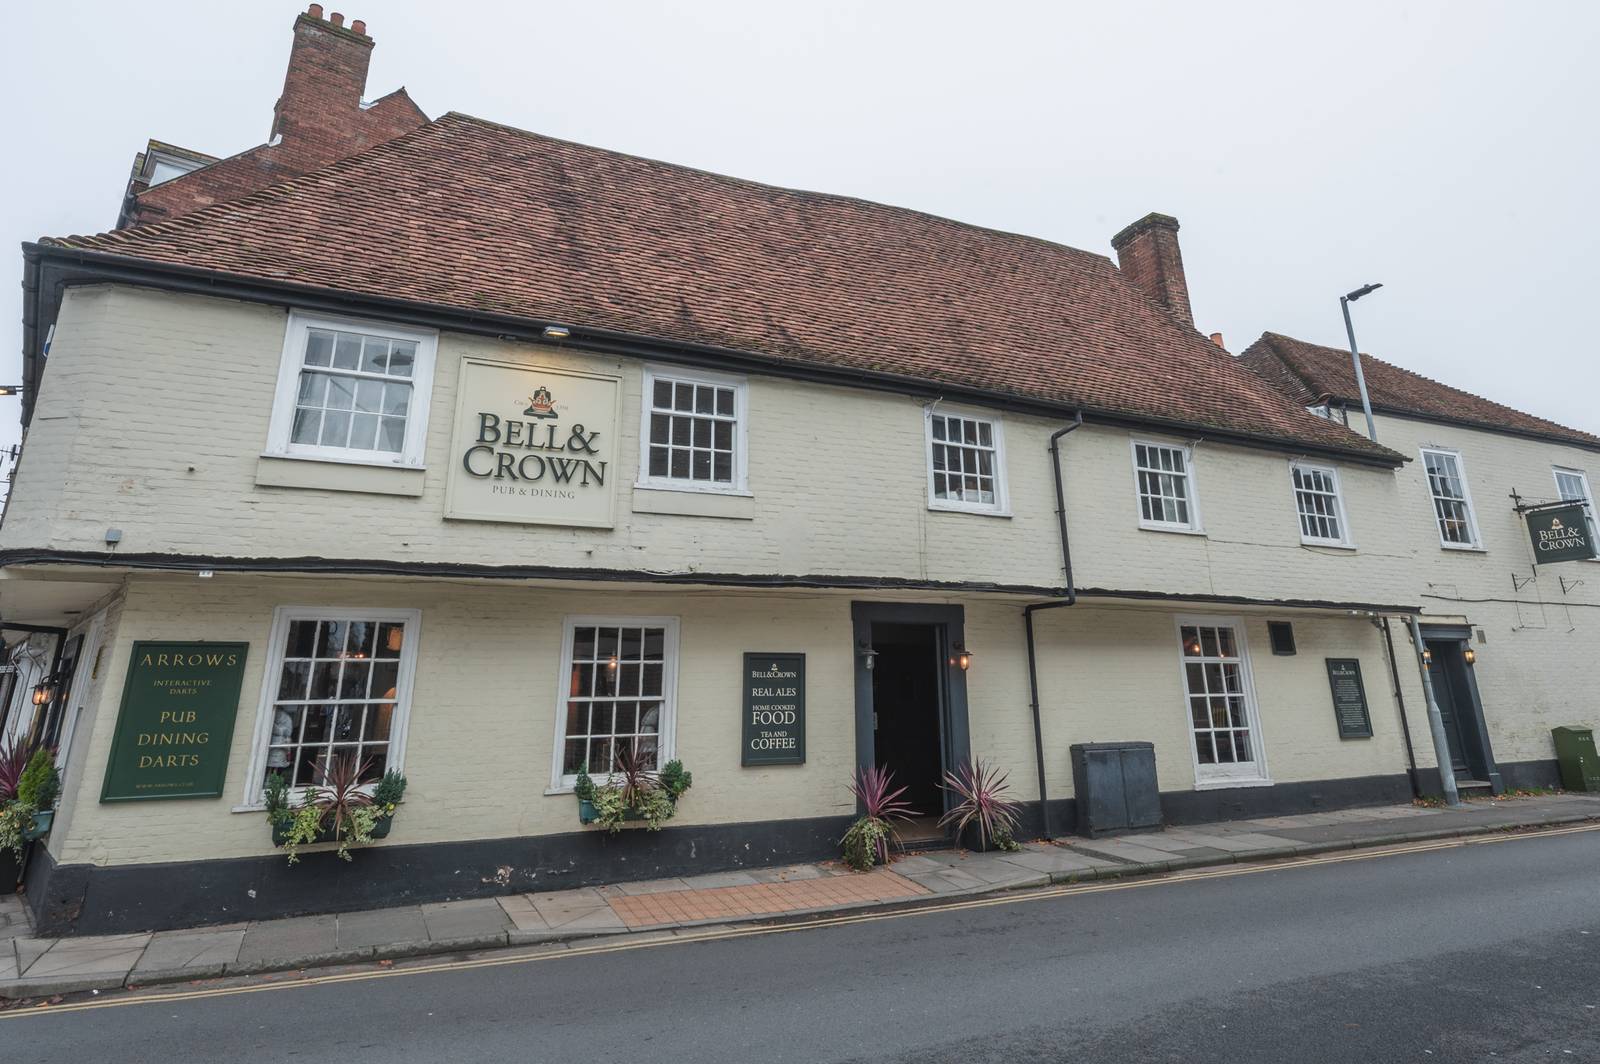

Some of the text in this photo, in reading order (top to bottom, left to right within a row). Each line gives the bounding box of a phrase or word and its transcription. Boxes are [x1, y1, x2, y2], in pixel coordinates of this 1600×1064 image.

[463, 445, 608, 487] CROWN
[492, 485, 576, 500] PUB & DINING
[1538, 537, 1585, 551] CROWN
[140, 653, 238, 667] ARROWS
[153, 679, 213, 687] INTERACTIVE
[752, 687, 797, 697] REAL ALES
[160, 711, 197, 724] PUB
[752, 710, 796, 725] FOOD
[137, 732, 209, 746] DINING
[760, 730, 788, 738] TEA AND
[751, 737, 796, 750] COFFEE
[139, 754, 200, 769] DARTS
